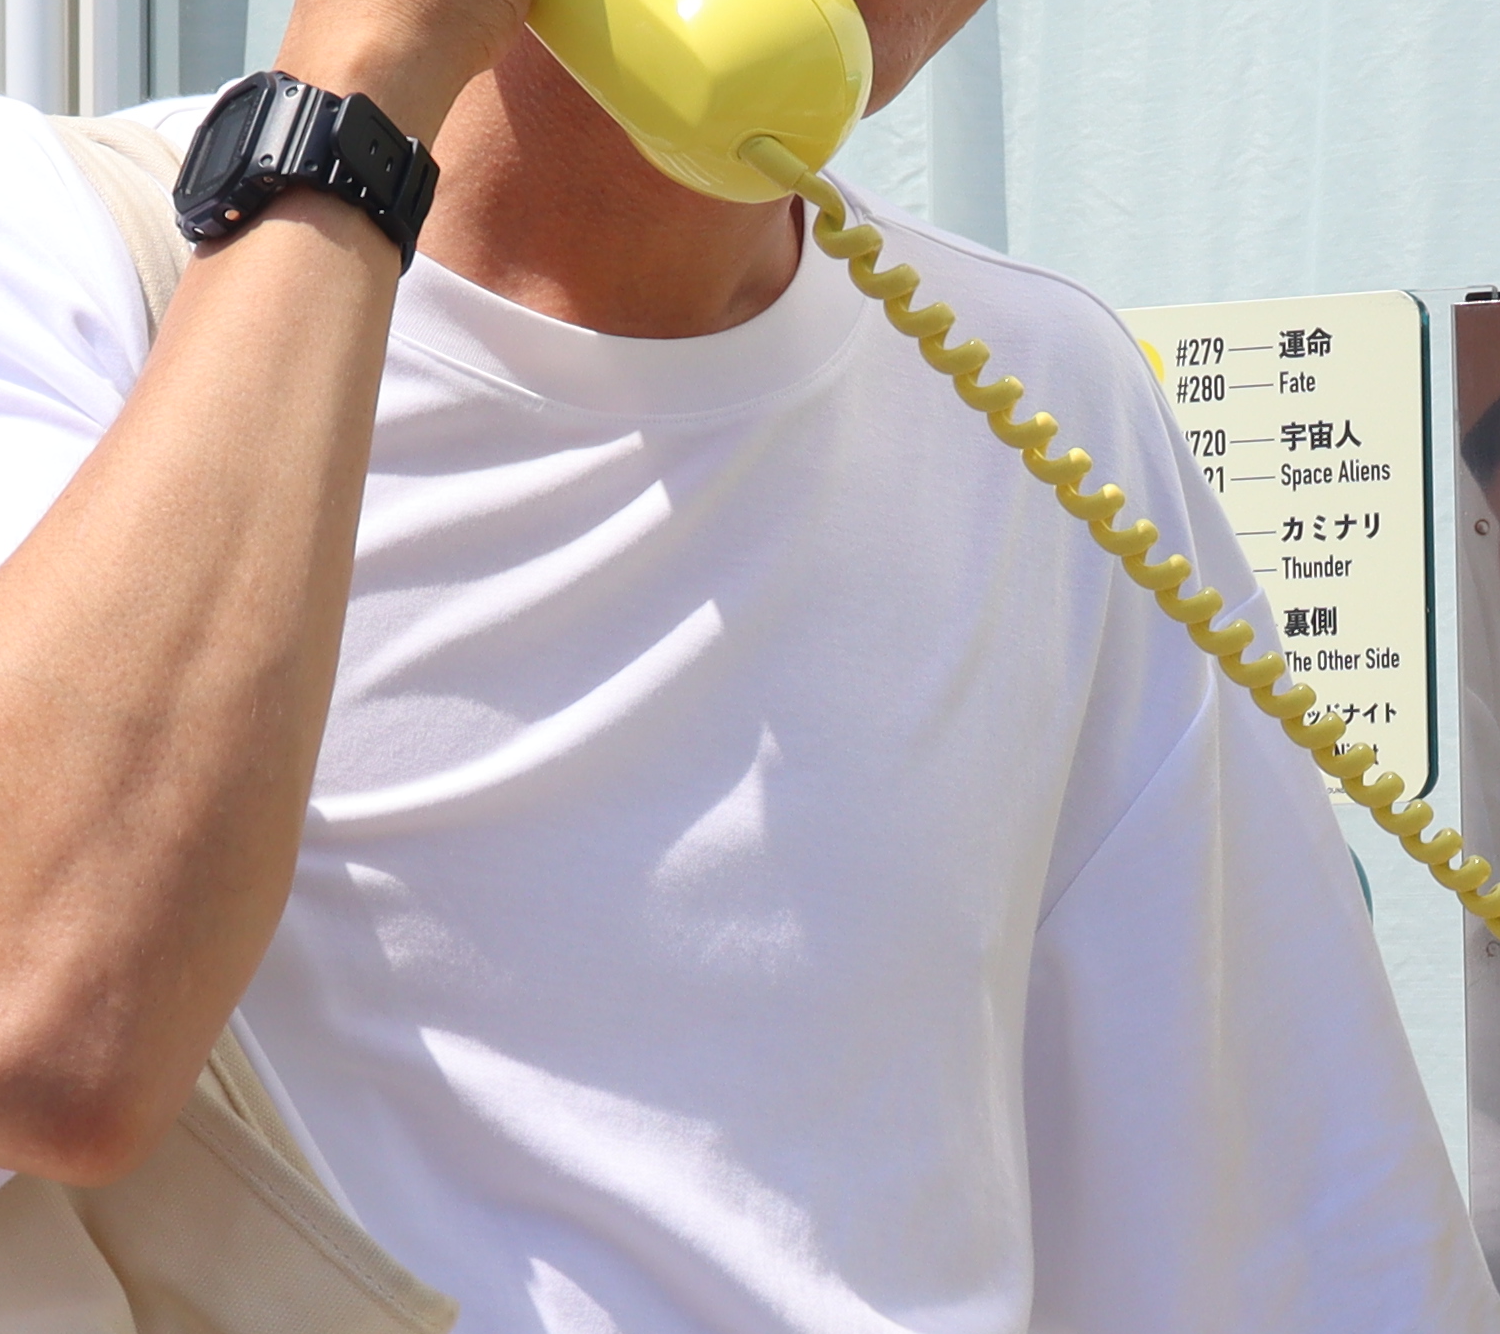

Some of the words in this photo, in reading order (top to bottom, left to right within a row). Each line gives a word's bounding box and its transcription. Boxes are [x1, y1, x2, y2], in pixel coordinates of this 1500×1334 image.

[1175, 337, 1224, 367] #279
[1279, 328, 1332, 359] 運命
[1176, 374, 1225, 403] #280
[1279, 371, 1316, 394] Fate
[1280, 420, 1362, 452] 宇宙人
[1280, 463, 1333, 492] Space
[1338, 460, 1391, 484] Aliens
[1281, 512, 1381, 542] カミナリ
[1281, 555, 1352, 580] Thunder
[1283, 607, 1337, 637] 裏側
[1285, 651, 1312, 672] The
[1317, 650, 1361, 671] Other
[1365, 648, 1400, 669] Side
